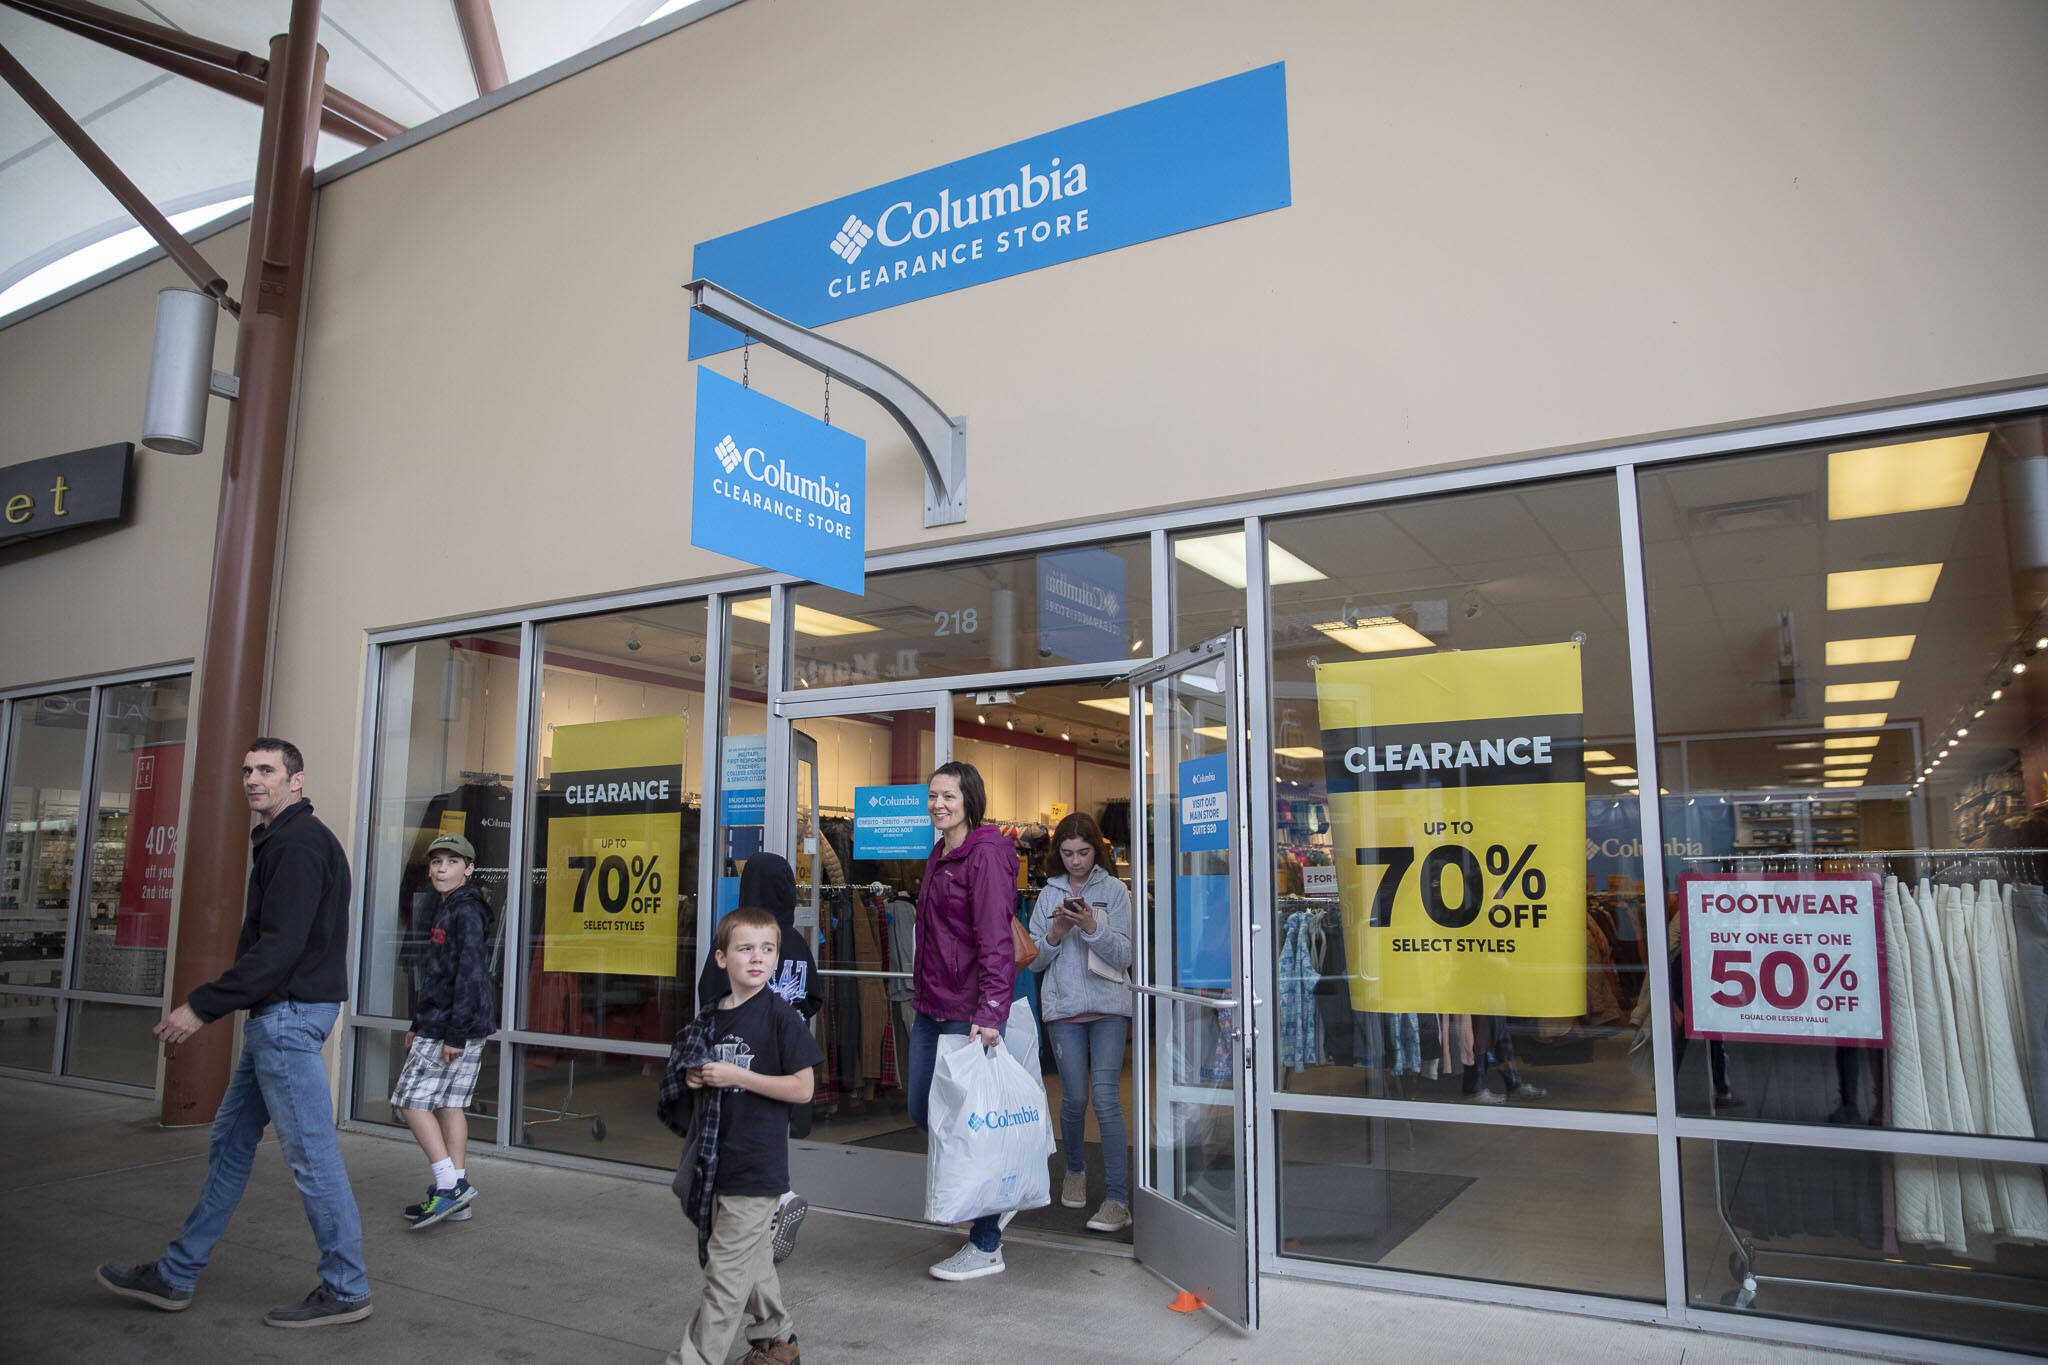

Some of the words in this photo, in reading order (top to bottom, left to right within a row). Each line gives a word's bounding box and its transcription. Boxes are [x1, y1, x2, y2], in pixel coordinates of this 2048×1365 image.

[876, 157, 1088, 247] Columbia
[828, 239, 983, 298] CLEARANCE
[997, 209, 1089, 253] STORE
[743, 447, 852, 515] Columbia
[713, 478, 802, 523] CLEARANCE
[808, 513, 852, 540] STORE
[934, 608, 980, 637] 218
[1344, 735, 1553, 774] CLEARANCE
[565, 780, 670, 805] CLEARANCE
[879, 795, 920, 807] Columbia
[1192, 798, 1204, 809] VISIT
[1205, 797, 1217, 807] OUR
[1189, 809, 1203, 821] MAIN
[1203, 808, 1220, 819] STORE
[1192, 824, 1207, 835] SUITE
[1424, 822, 1447, 836] UP
[1450, 821, 1474, 835] TO
[145, 825, 178, 855] 40%
[601, 839, 615, 849] UP
[616, 838, 627, 849] TO
[145, 864, 157, 880] off
[1307, 875, 1313, 883] 2
[1314, 874, 1333, 883] FOR
[142, 884, 157, 900] 2nd
[568, 854, 662, 914] 70%
[1355, 844, 1547, 929] 70%
[631, 897, 662, 914] OFF
[1701, 893, 1859, 915] FOOTWEAR
[1488, 904, 1548, 929] OFF
[583, 920, 613, 931] SELECT
[614, 921, 645, 931] STYLES
[1392, 938, 1454, 952] SELECT
[1456, 939, 1516, 953] STYLES
[1710, 932, 1742, 944] BUY
[1745, 932, 1779, 945] ONE
[1782, 933, 1813, 945] GET
[1817, 933, 1852, 946] ONE
[1710, 950, 1859, 1010] 50%
[1816, 994, 1859, 1012] OFF
[1740, 1013, 1765, 1021] EQUAL
[1766, 1014, 1777, 1022] OR
[1778, 1014, 1804, 1023] LESSER
[1805, 1016, 1829, 1024] VALUE
